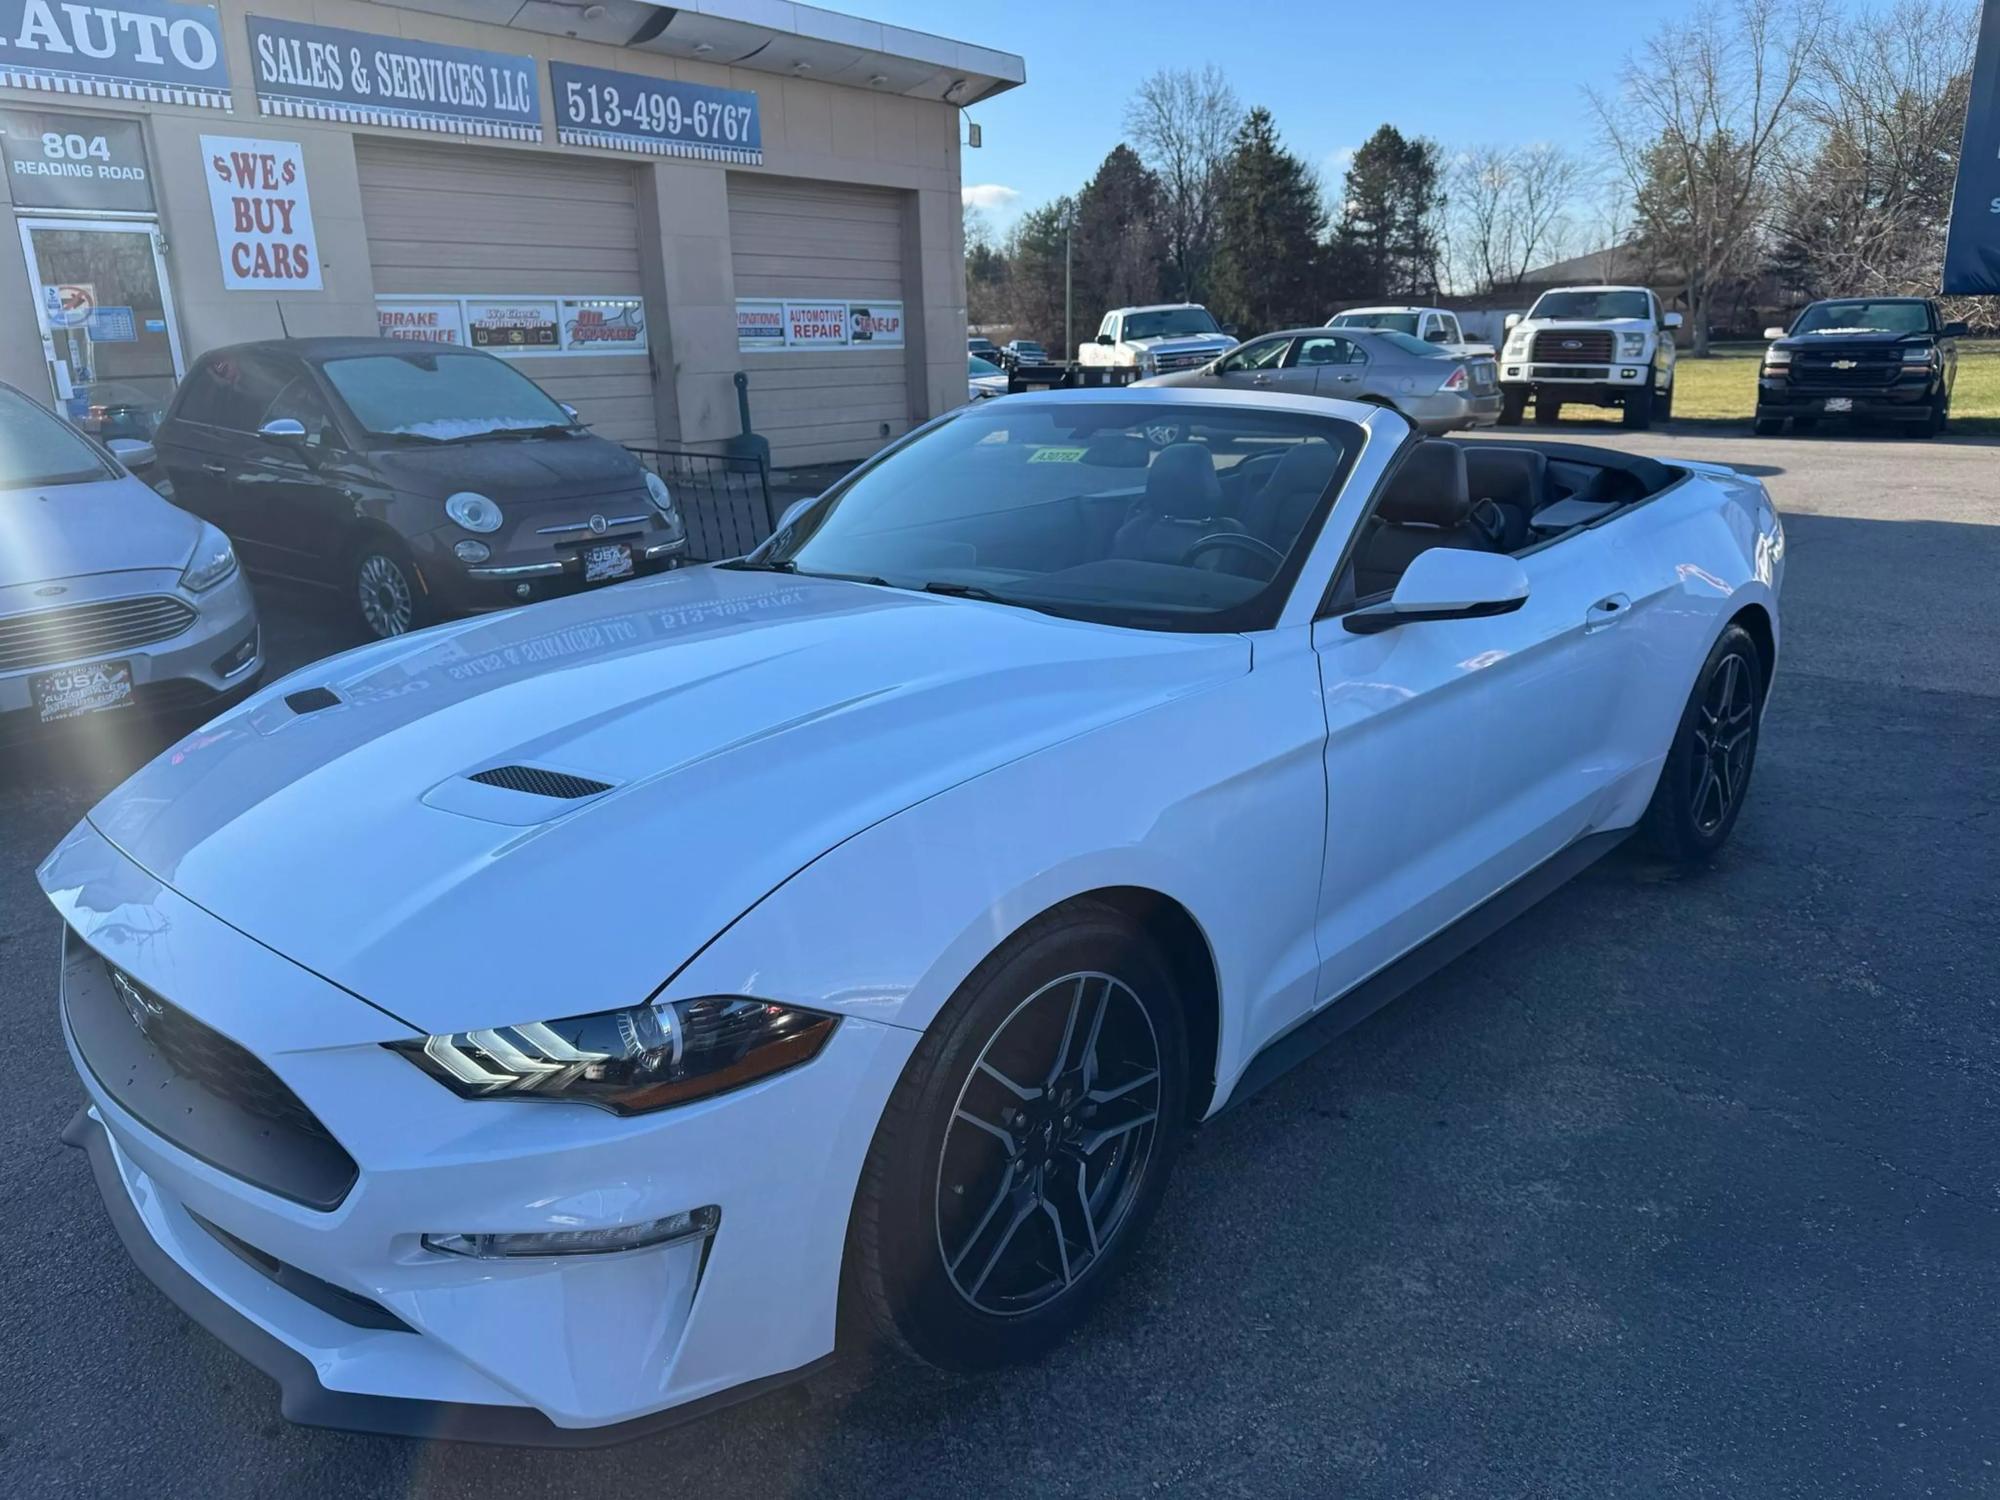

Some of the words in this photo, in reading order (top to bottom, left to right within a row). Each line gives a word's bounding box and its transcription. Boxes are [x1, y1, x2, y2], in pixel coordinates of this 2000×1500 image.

[15, 0, 217, 70] AUTO
[257, 33, 344, 91] SALES
[350, 47, 370, 95] &
[375, 51, 487, 109] SERVICES
[491, 68, 530, 113] LLC
[566, 81, 752, 142] 513-499-6767
[42, 133, 111, 161] 804
[14, 161, 94, 178] READING
[99, 165, 145, 180] ROAD
[232, 197, 295, 234] BUY
[232, 242, 309, 279] CARS
[382, 312, 438, 326] BRAKE
[790, 310, 844, 322] AUTOMOTIVE
[392, 329, 456, 343] SERVICE
[794, 324, 842, 339] REPAIR
[54, 671, 110, 691] USA
